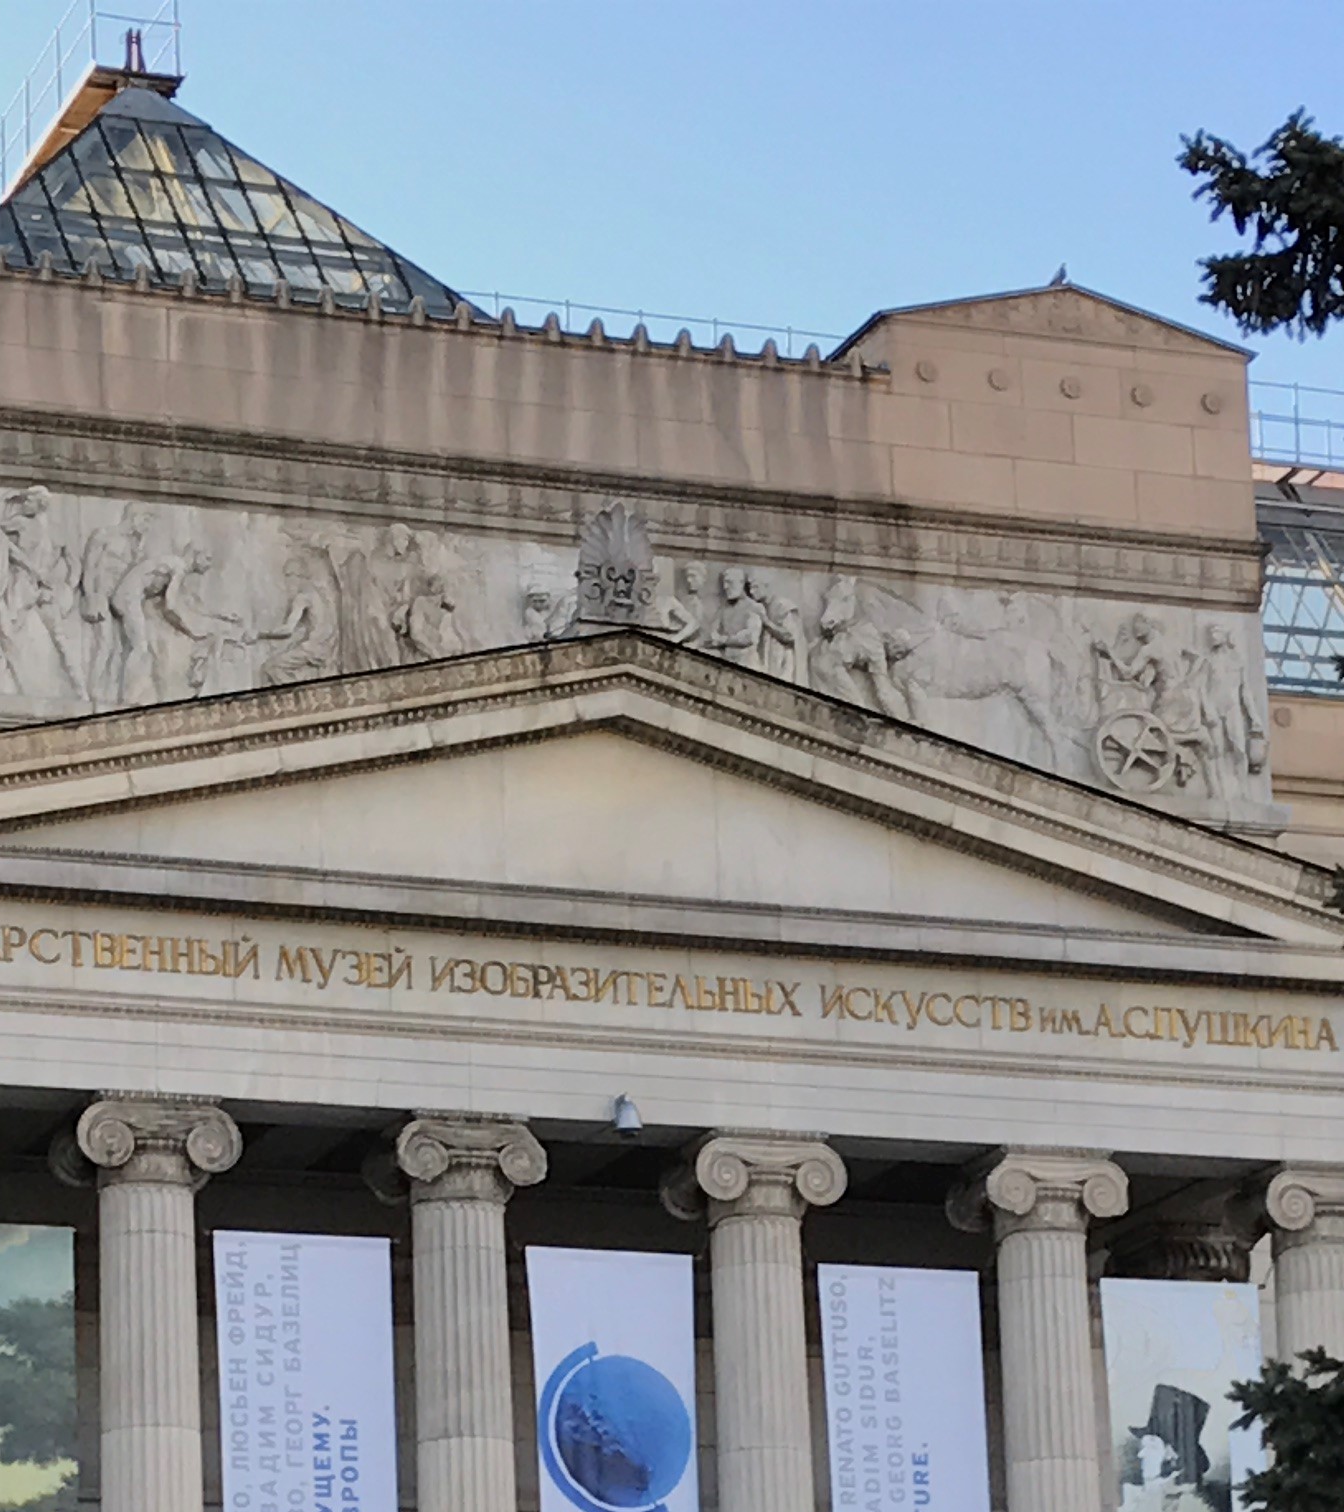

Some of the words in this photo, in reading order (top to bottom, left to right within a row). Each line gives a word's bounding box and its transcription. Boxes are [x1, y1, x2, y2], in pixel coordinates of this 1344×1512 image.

[276, 945, 412, 991] МУЗЕЙ
[431, 956, 801, 1017] ИЗОБРАЗИТЕЛЬНЫХ
[819, 984, 1033, 1032] ИСКУССТВ
[280, 1241, 302, 1373] БАЗЕЛИЦ
[829, 1274, 852, 1396] GUTTUSO,
[878, 1276, 901, 1403] BASELITZ
[228, 1357, 251, 1472] ЛЮСЬЕН
[283, 1384, 304, 1469] ГЕОРГ
[836, 1406, 857, 1506] RENATO
[885, 1414, 906, 1504] GEORG
